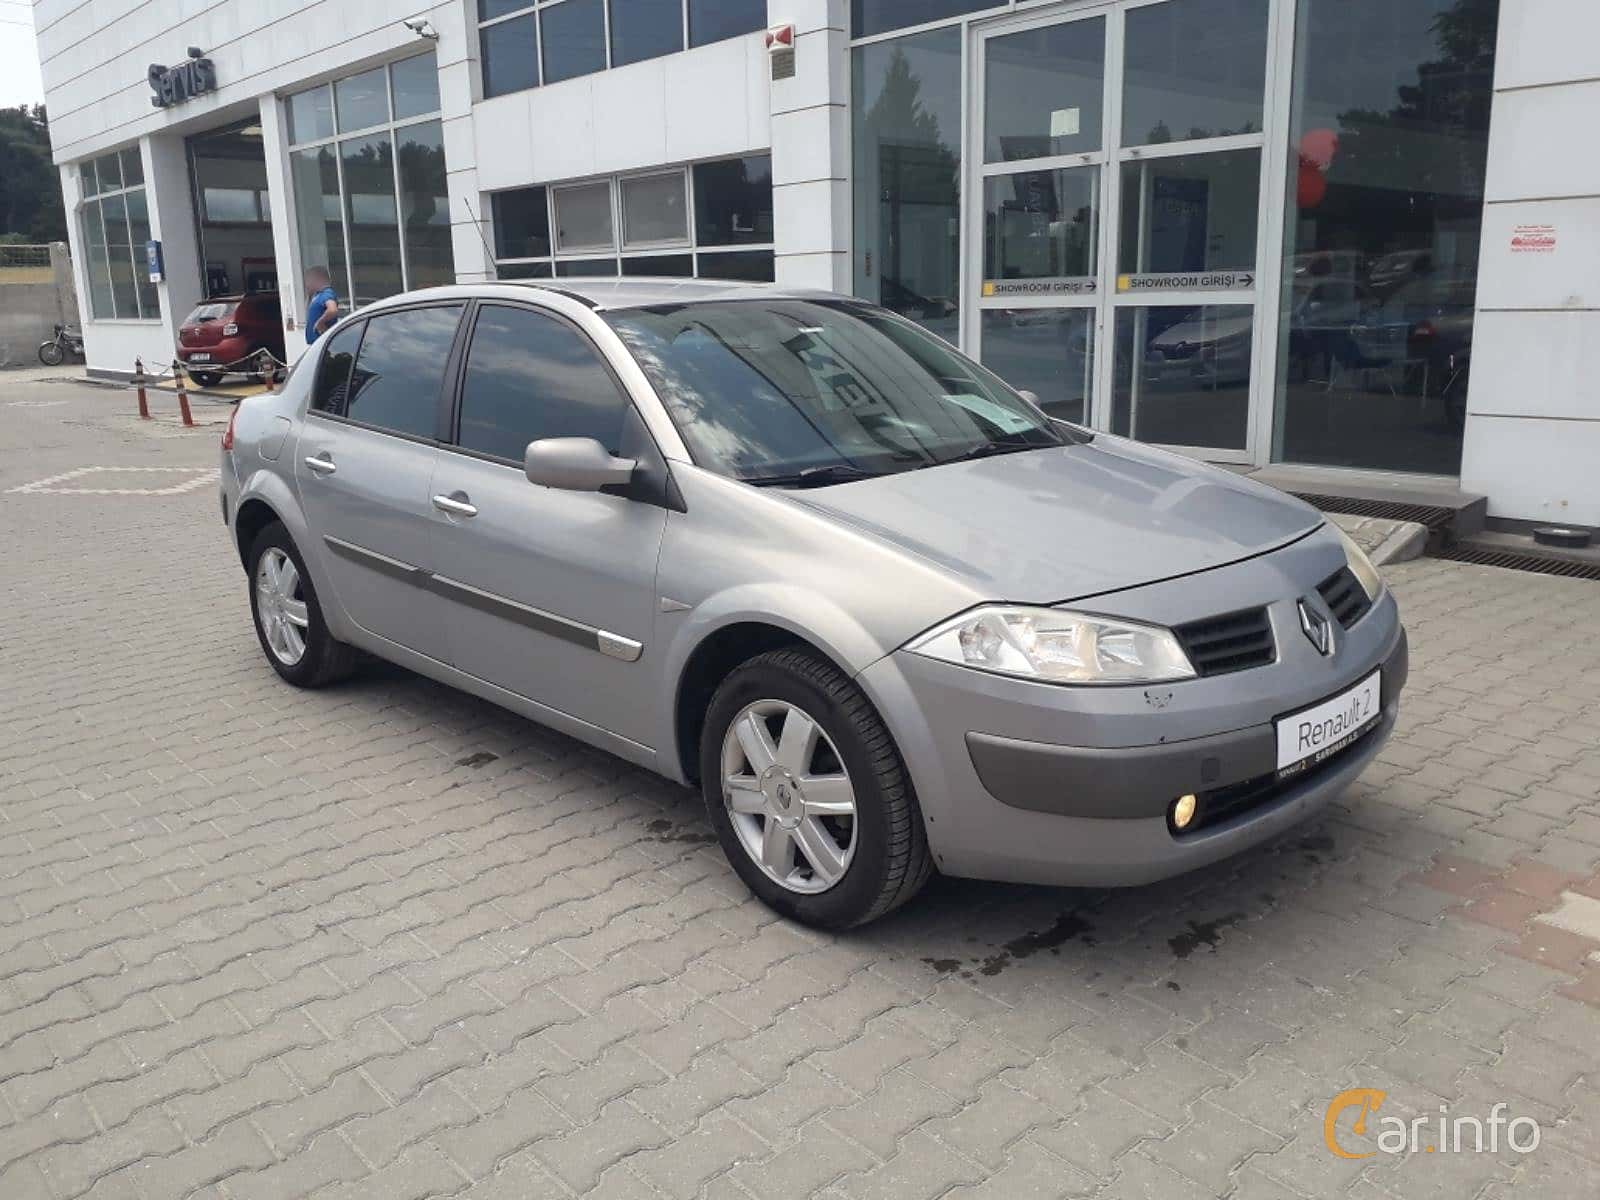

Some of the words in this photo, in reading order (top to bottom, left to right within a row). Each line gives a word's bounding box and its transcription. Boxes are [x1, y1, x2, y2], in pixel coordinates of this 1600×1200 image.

[994, 283, 1051, 293] SHOWROOM
[1130, 277, 1198, 288] SHOWROOM
[1298, 698, 1360, 752] Renault
[1363, 688, 1372, 716] 2
